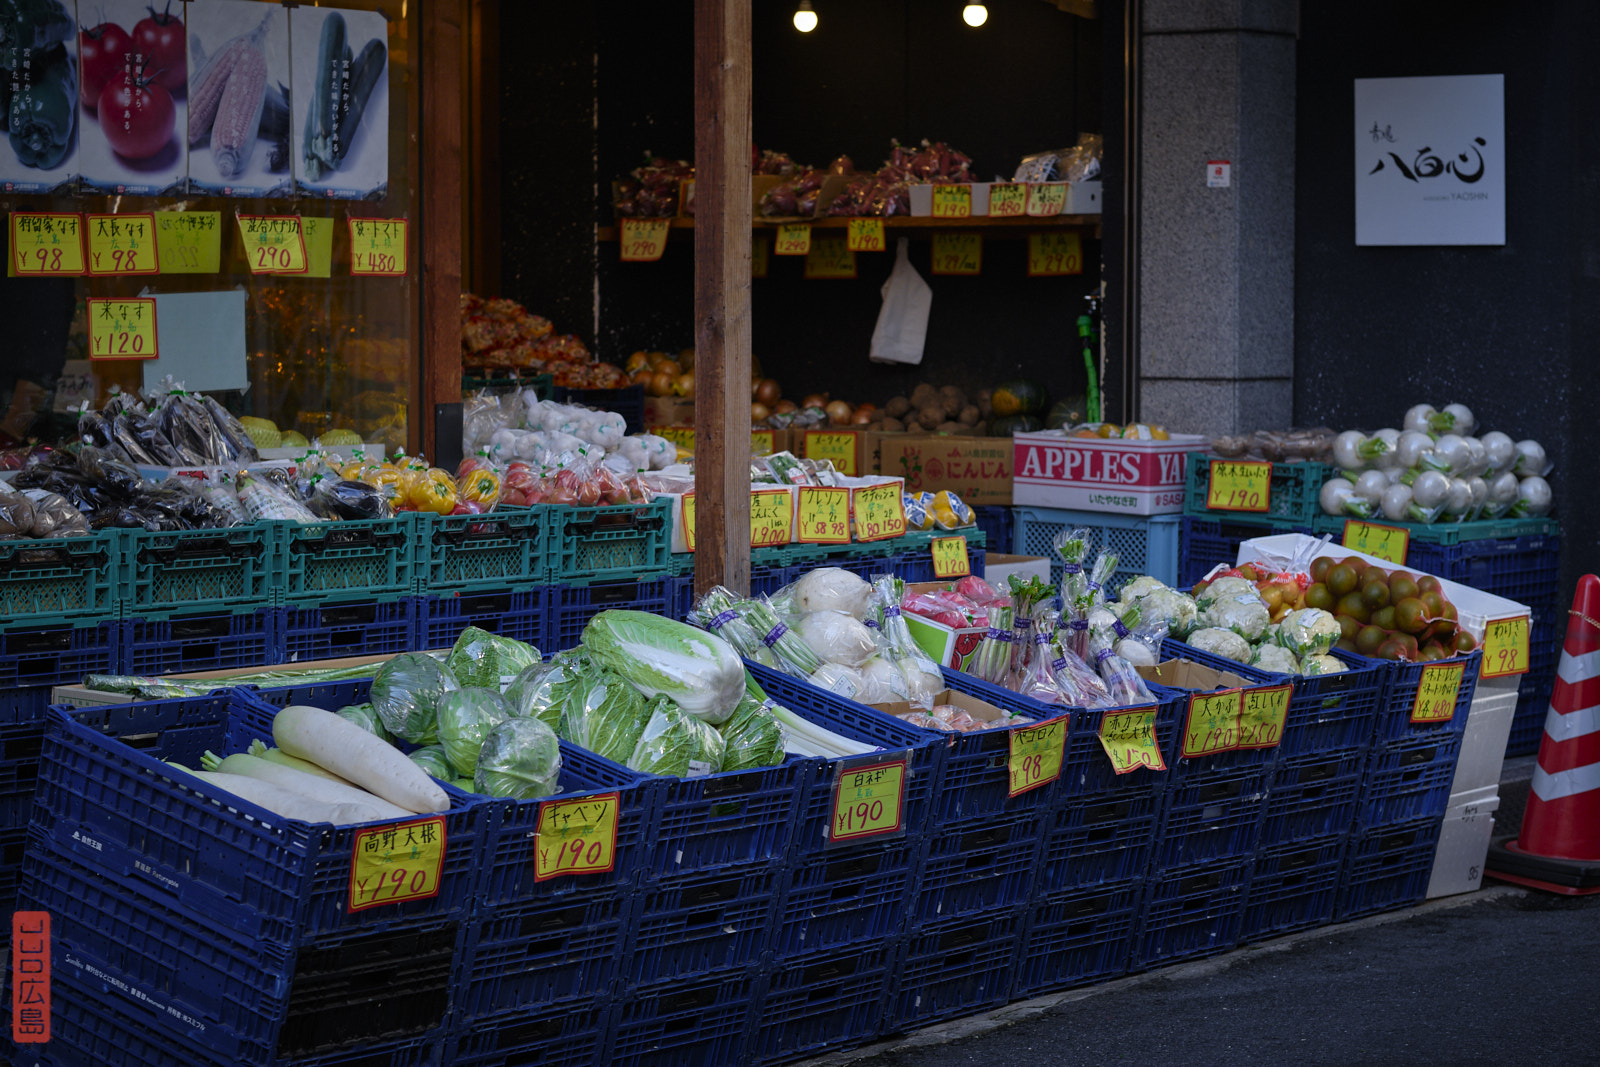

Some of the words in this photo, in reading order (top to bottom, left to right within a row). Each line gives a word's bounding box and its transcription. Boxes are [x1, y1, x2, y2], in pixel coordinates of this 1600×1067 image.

[97, 217, 145, 238] 大長なす
[257, 246, 291, 268] 290
[624, 240, 656, 256] ¥290
[19, 248, 63, 272] ¥98
[92, 250, 138, 272] ¥98
[356, 252, 396, 272] ¥480
[1031, 253, 1076, 272] ¥290
[100, 299, 145, 320] 米なす
[94, 332, 144, 354] ¥120
[947, 462, 1010, 479] にんじん
[1021, 446, 1141, 484] APPLES
[807, 488, 843, 505] クレソン
[1089, 493, 1138, 507] いたやなぎ町
[1214, 489, 1259, 508] ¥190
[832, 522, 844, 535] 98
[883, 519, 902, 532] 150
[937, 558, 965, 574] ¥120
[1494, 620, 1521, 639] わけぎ
[1486, 648, 1518, 672] ¥98
[1201, 697, 1236, 717] 大かぶ
[1109, 713, 1146, 730] 赤カブ
[1014, 723, 1057, 744] ペコロス
[1190, 728, 1233, 752] ¥190
[1240, 722, 1277, 745] ¥150
[854, 769, 887, 787] 白ネギ
[1012, 754, 1042, 786] ¥98
[549, 802, 608, 827] キャベツ
[838, 800, 883, 831] ¥190
[365, 824, 437, 852] 高野大根
[540, 838, 602, 869] ¥190
[357, 868, 426, 900] ¥190
